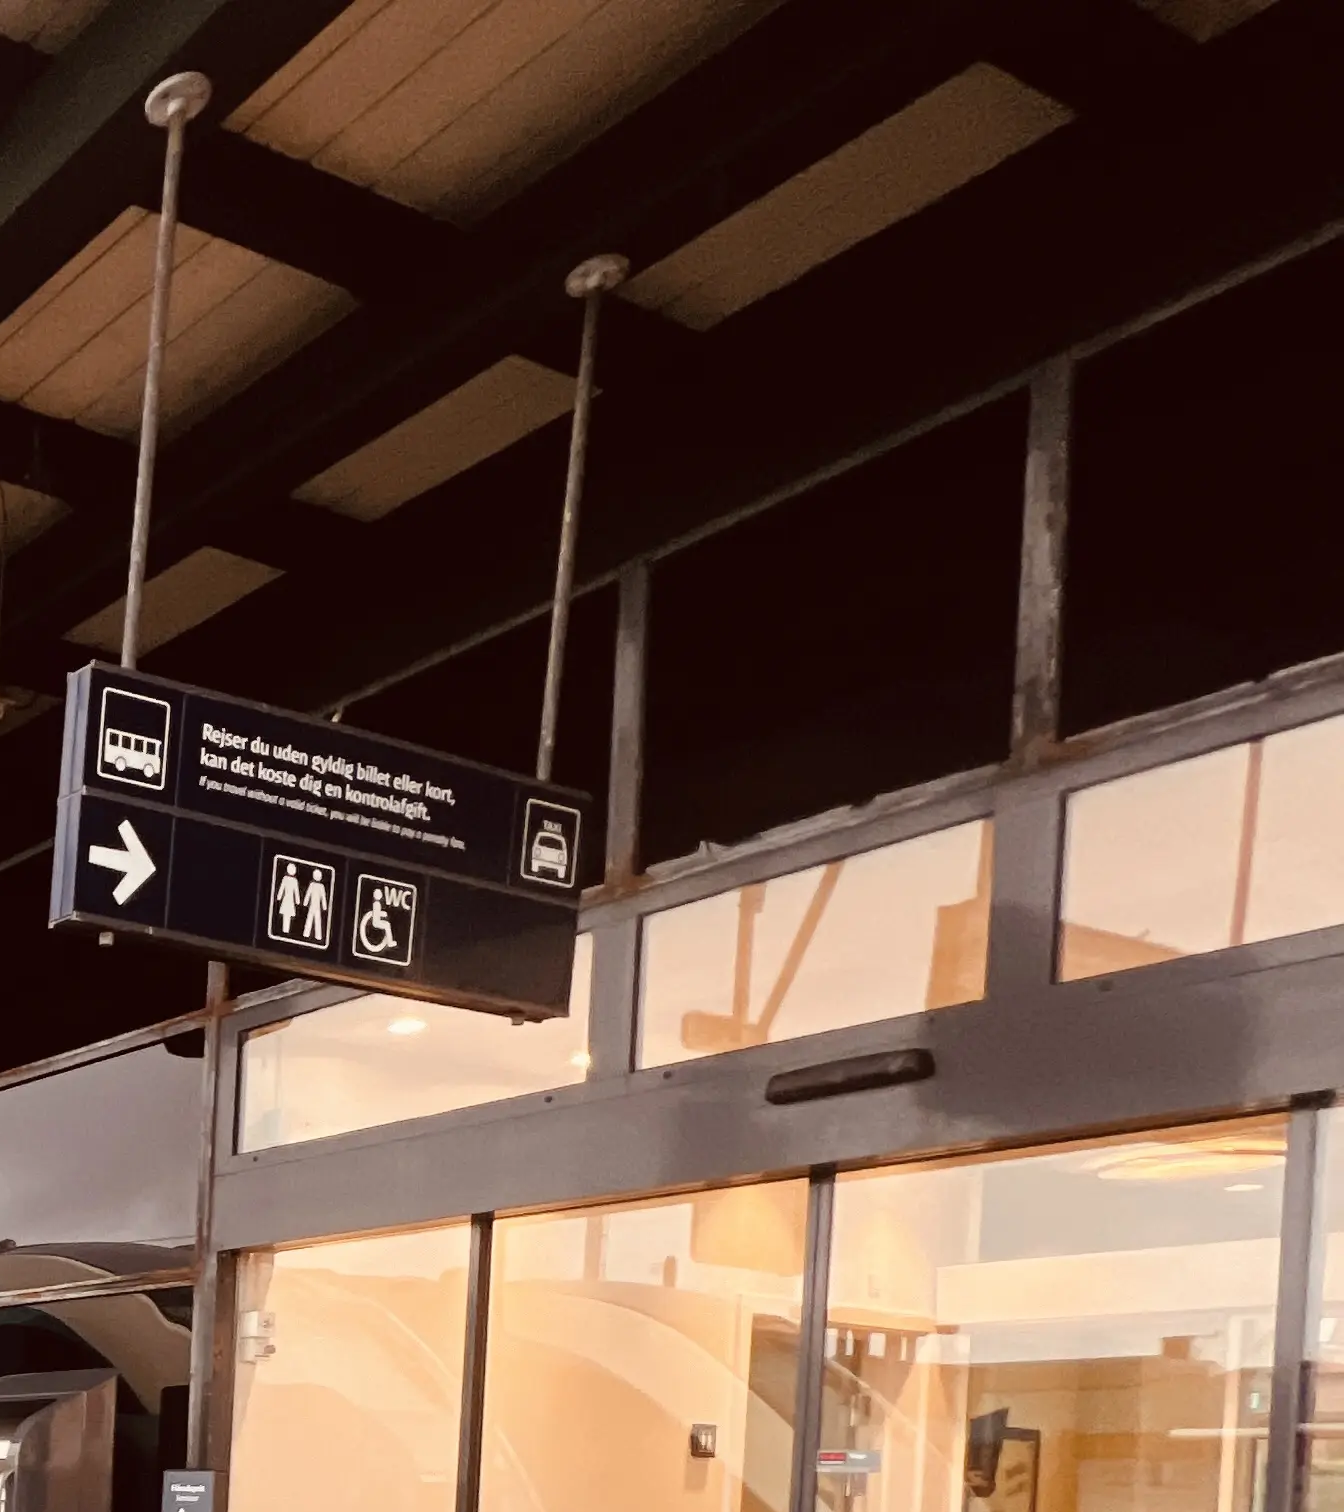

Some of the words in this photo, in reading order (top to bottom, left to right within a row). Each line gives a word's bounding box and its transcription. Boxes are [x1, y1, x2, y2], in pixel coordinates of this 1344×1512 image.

[200, 747, 227, 770] kan
[231, 756, 255, 777] det
[258, 762, 297, 787] koste
[299, 773, 322, 797] dig
[325, 783, 342, 799] en
[345, 783, 431, 821] kontrolafgift.
[202, 723, 248, 750] Rejser
[250, 736, 270, 756] du
[273, 744, 308, 766] uden
[311, 755, 353, 780] gyldig
[356, 762, 391, 787] billet
[393, 774, 423, 794] eller
[425, 780, 456, 806] kort,
[384, 885, 411, 911] WC
